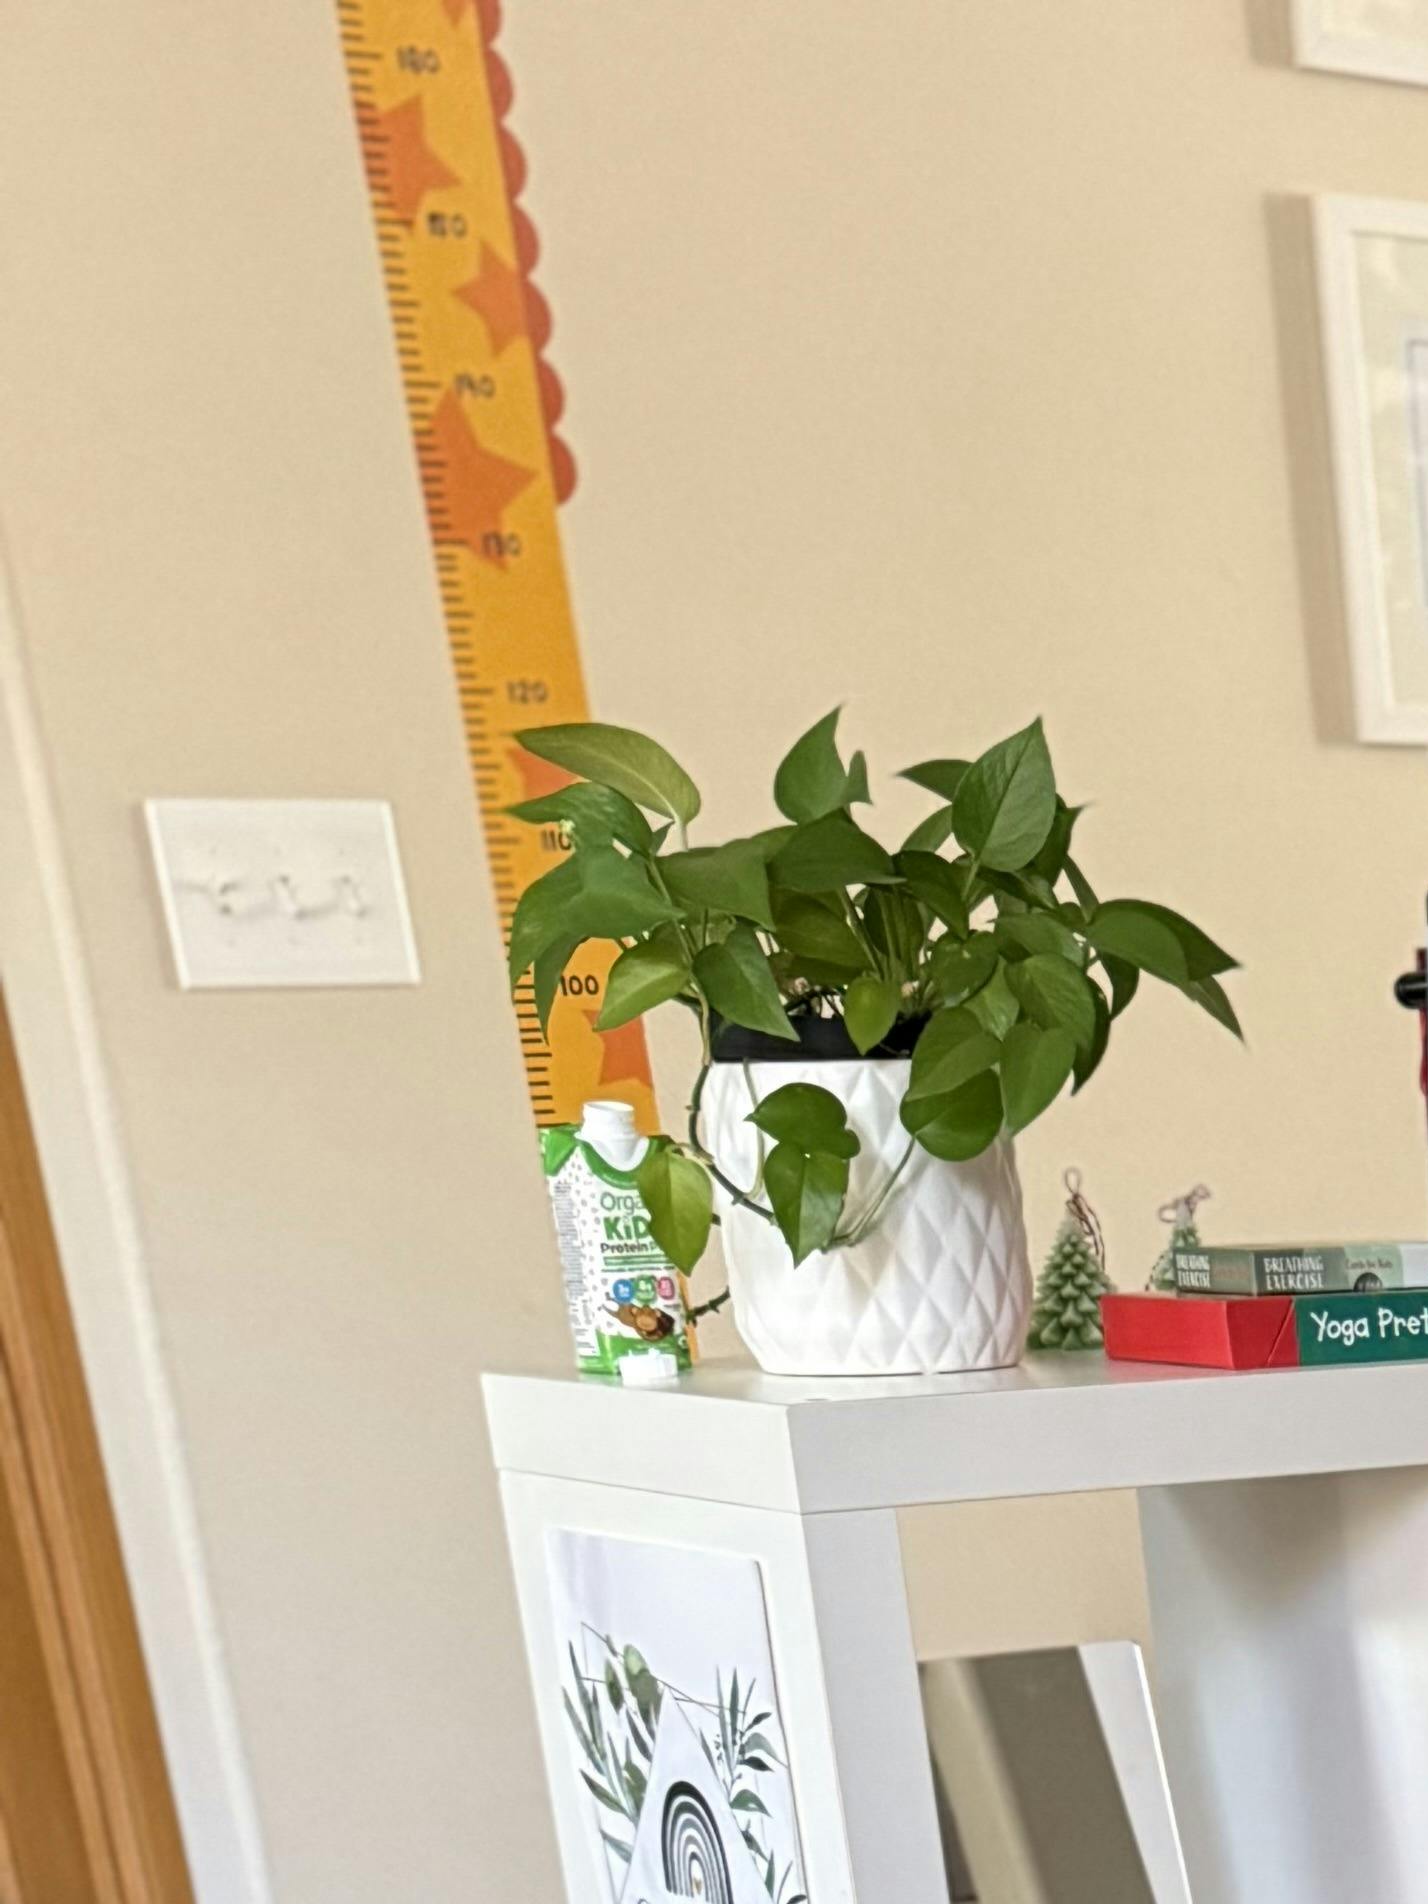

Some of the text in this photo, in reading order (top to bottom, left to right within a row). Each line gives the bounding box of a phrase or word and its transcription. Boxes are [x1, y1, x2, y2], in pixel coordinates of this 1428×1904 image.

[507, 681, 548, 703] 120
[559, 975, 600, 997] 100
[1263, 1255, 1324, 1273] BREATHING
[1266, 1273, 1324, 1290] EXERCISE
[1310, 1310, 1370, 1346] Yoga
